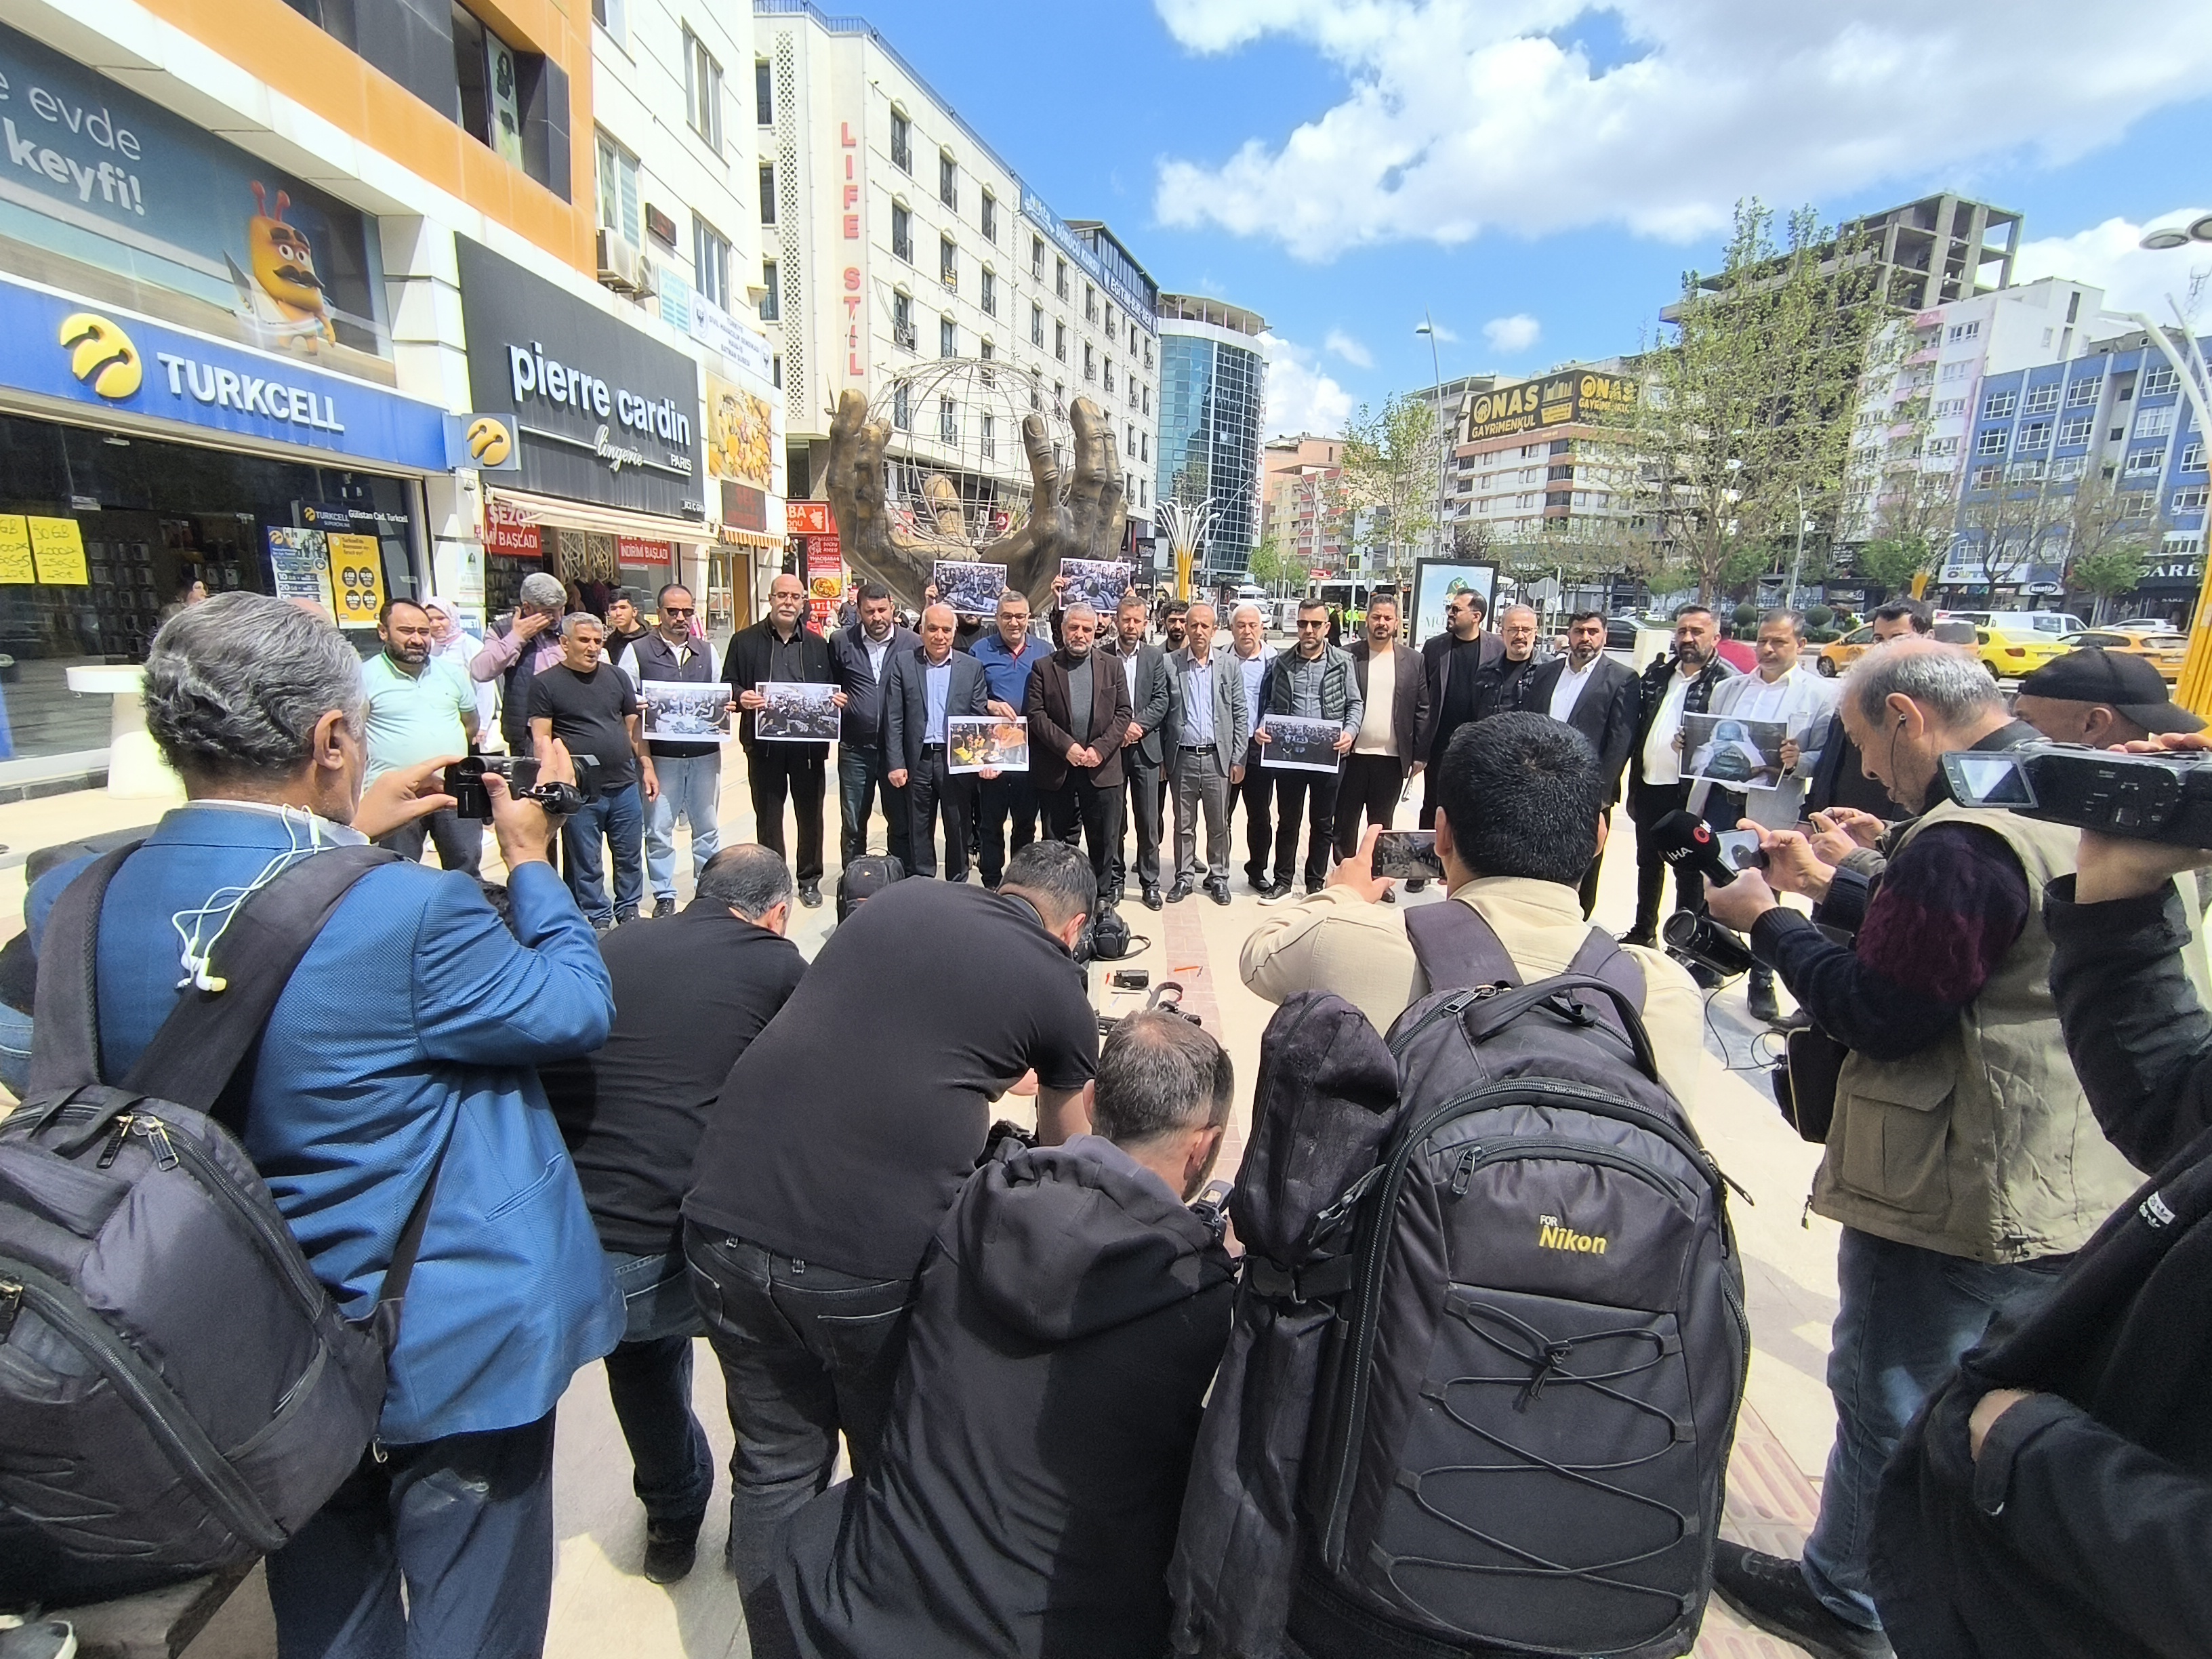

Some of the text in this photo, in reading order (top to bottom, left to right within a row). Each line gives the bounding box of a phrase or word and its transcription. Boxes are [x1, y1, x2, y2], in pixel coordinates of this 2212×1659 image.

[29, 87, 141, 160] evde
[3, 117, 145, 216] keyfi!
[841, 122, 859, 238] LIFE
[1056, 222, 1081, 257] SÜRÜCÜ
[1081, 251, 1101, 275] KURSU
[157, 352, 345, 432] TURKCELL
[510, 341, 691, 446] pierre cardin
[1473, 384, 1540, 424] ONAS
[594, 424, 643, 472] lingerie
[671, 453, 692, 471] PARIS
[315, 510, 350, 522] TURKCELL
[348, 509, 373, 520] Gülistan
[386, 513, 409, 523] Turkcell
[1254, 478, 1263, 536] CENTER
[498, 531, 537, 549] BAŞLADI
[620, 543, 668, 560] İNDİRİMİ BAŞLADI
[1539, 1225, 1607, 1254] Nikon
[1540, 1214, 1558, 1227] FOR
